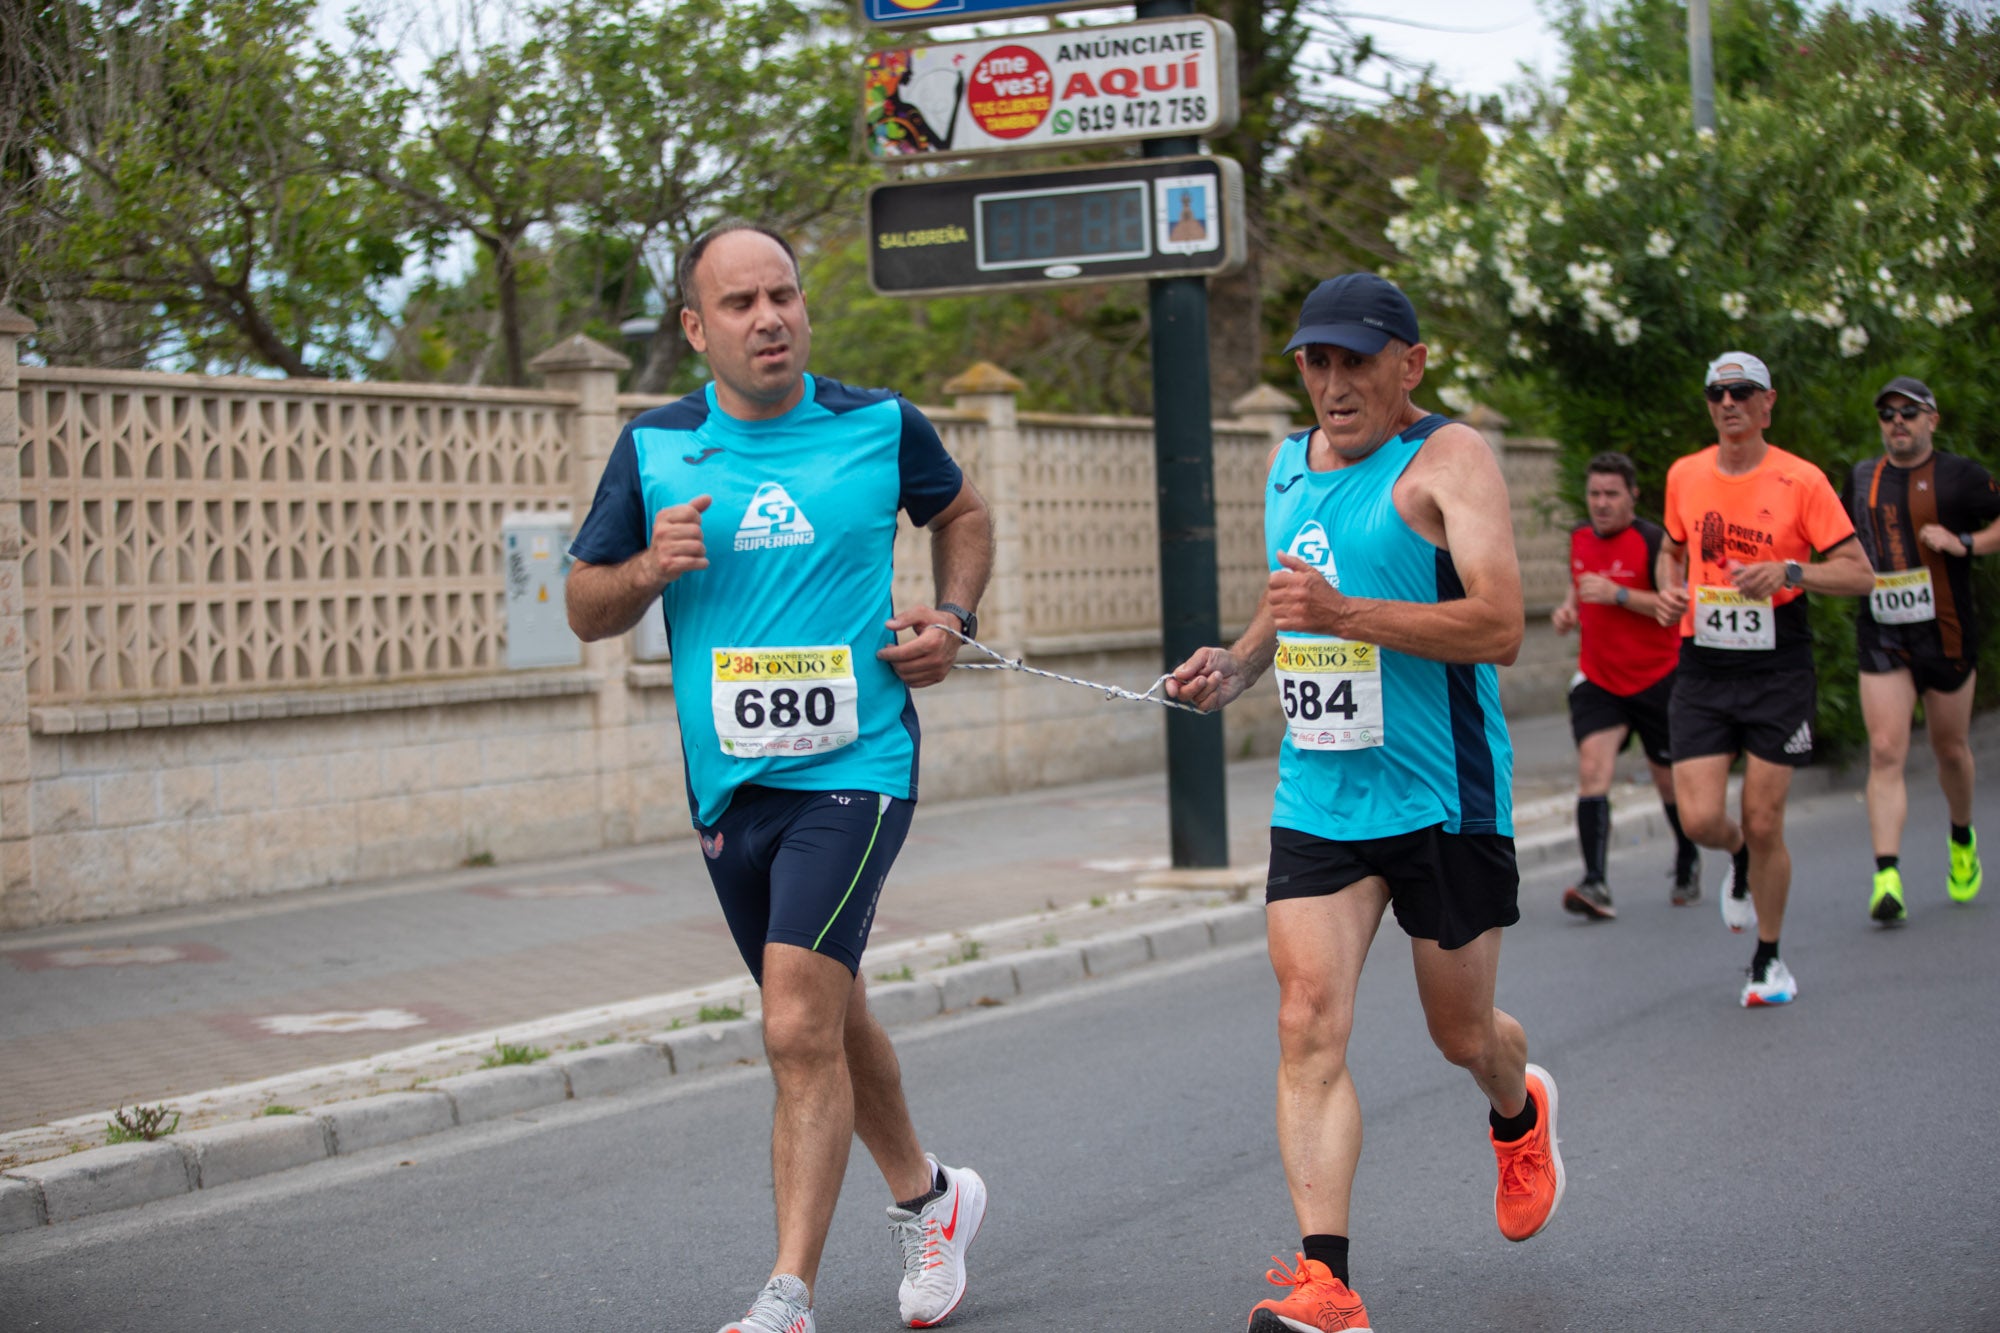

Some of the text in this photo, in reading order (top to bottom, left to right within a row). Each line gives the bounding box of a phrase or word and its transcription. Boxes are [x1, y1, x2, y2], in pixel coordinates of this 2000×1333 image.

[1056, 31, 1204, 62] ANÚNCIATE
[975, 56, 1028, 84] ¿me
[992, 70, 1049, 97] ves?
[1061, 52, 1200, 100] AQUÍ
[1078, 97, 1206, 131] 619 472 758
[878, 224, 968, 249] SALOBREÑA
[1728, 524, 1773, 546] PRUEBA
[1875, 587, 1931, 611] 1004
[1707, 609, 1762, 633] 413
[733, 656, 825, 675] 38 FONDO
[1288, 652, 1347, 666] FONDO
[734, 687, 836, 729] 680
[1284, 679, 1358, 721] 584
